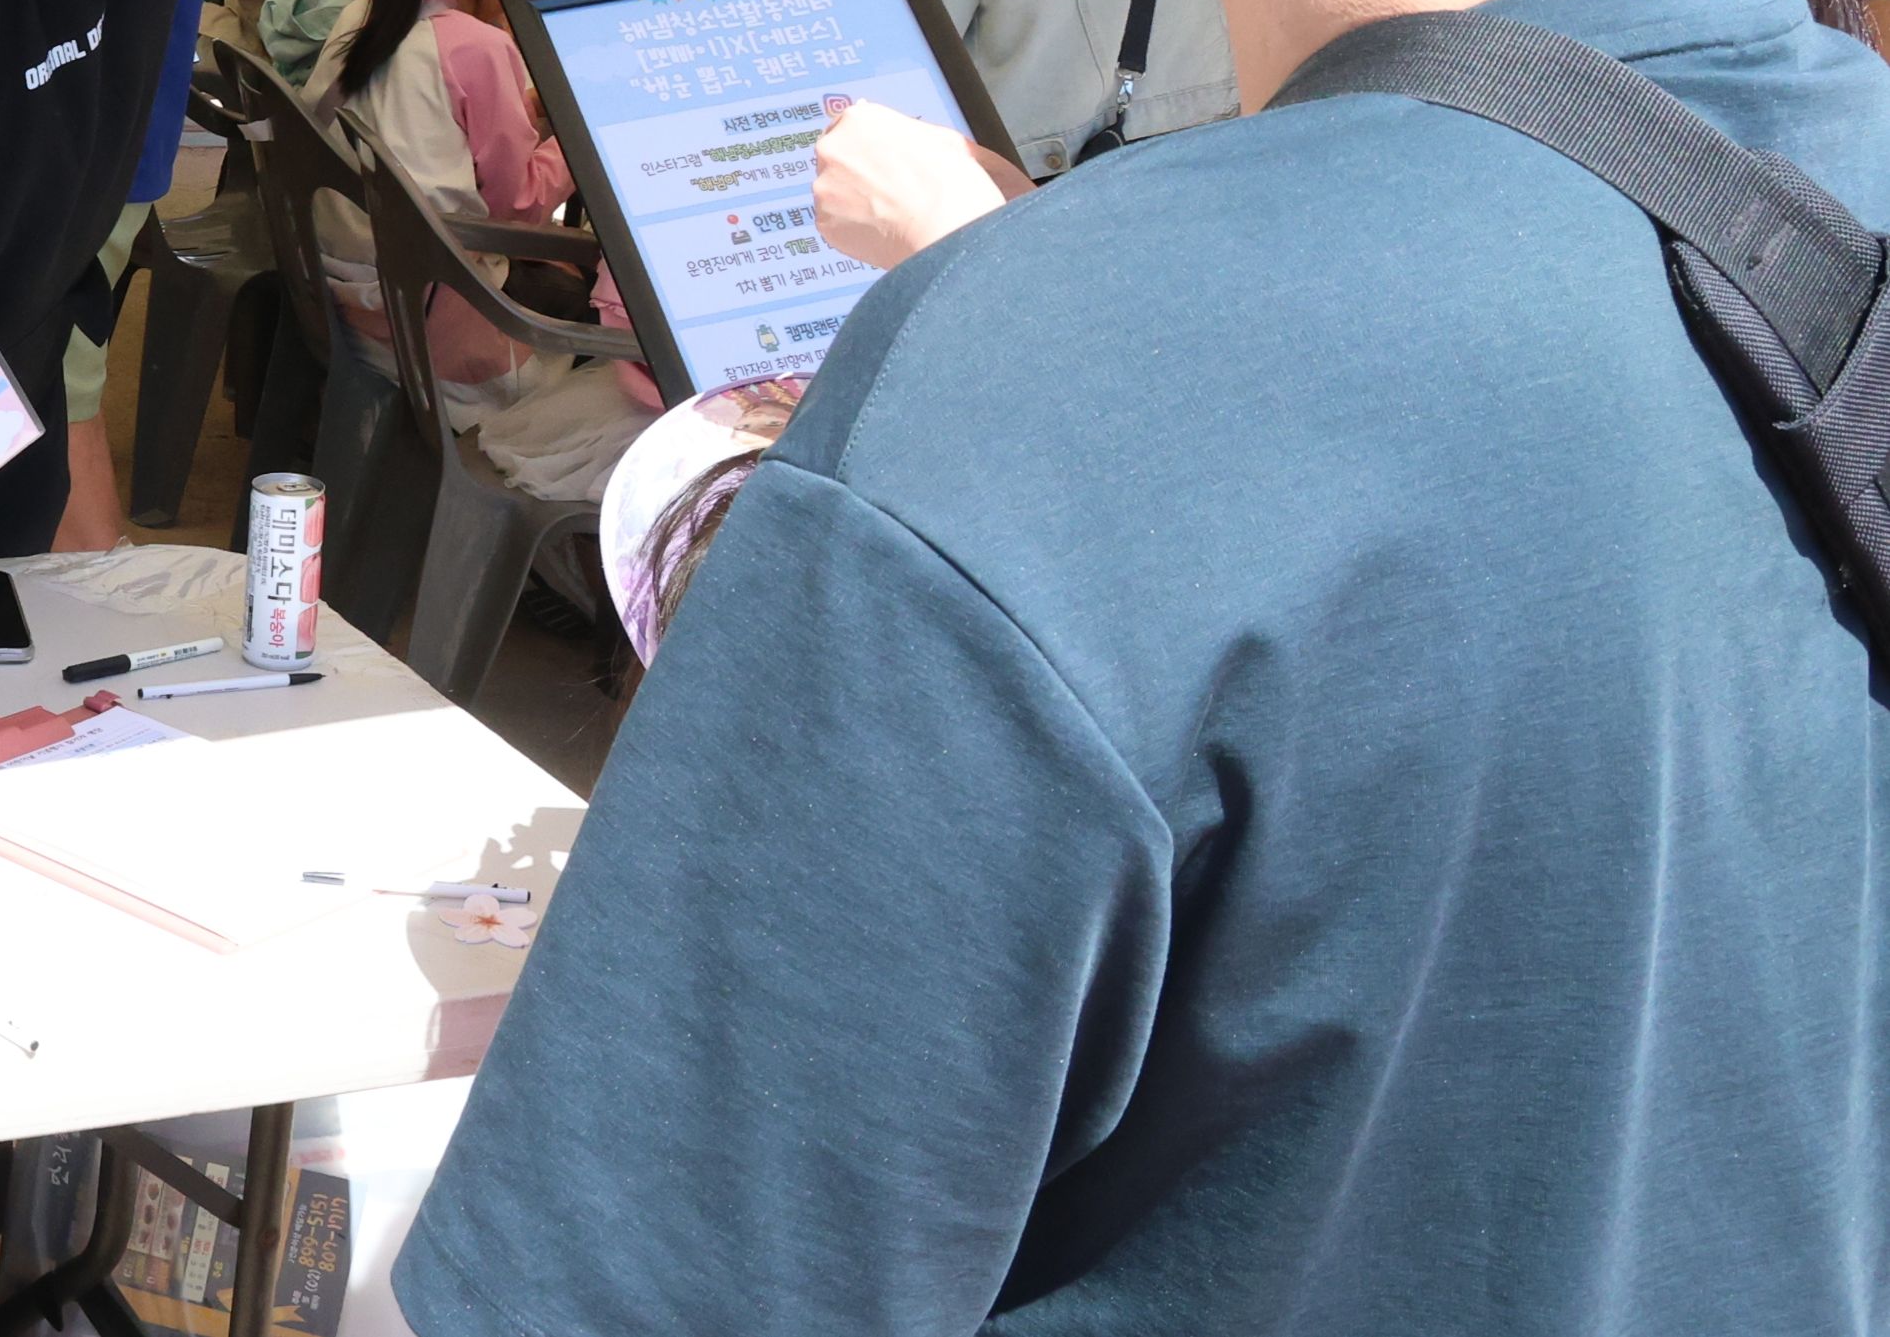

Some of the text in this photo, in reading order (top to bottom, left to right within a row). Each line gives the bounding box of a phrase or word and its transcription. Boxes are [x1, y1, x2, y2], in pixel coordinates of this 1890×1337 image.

[697, 65, 751, 95] 뽑고,
[753, 51, 808, 85] 랜턴
[724, 102, 823, 132] 사전 참여 이벤트
[640, 151, 702, 177] 인스타그램
[773, 159, 809, 178] 응원의
[753, 212, 786, 233] 인형
[686, 250, 755, 277] 운영진에게
[757, 244, 785, 262] 코인
[785, 236, 821, 256] 1개를
[735, 277, 758, 295] 1차
[759, 273, 786, 292] 뽑기
[789, 266, 818, 286] 실패
[821, 263, 835, 277] 시
[723, 361, 773, 381] 참가자의
[775, 352, 814, 369] 취향에
[267, 509, 297, 605] 데미소다
[269, 608, 286, 648] 복숭아
[299, 1193, 328, 1268] 899-5151
[318, 1196, 348, 1272] 807-1717
[304, 1269, 322, 1293] (02)
